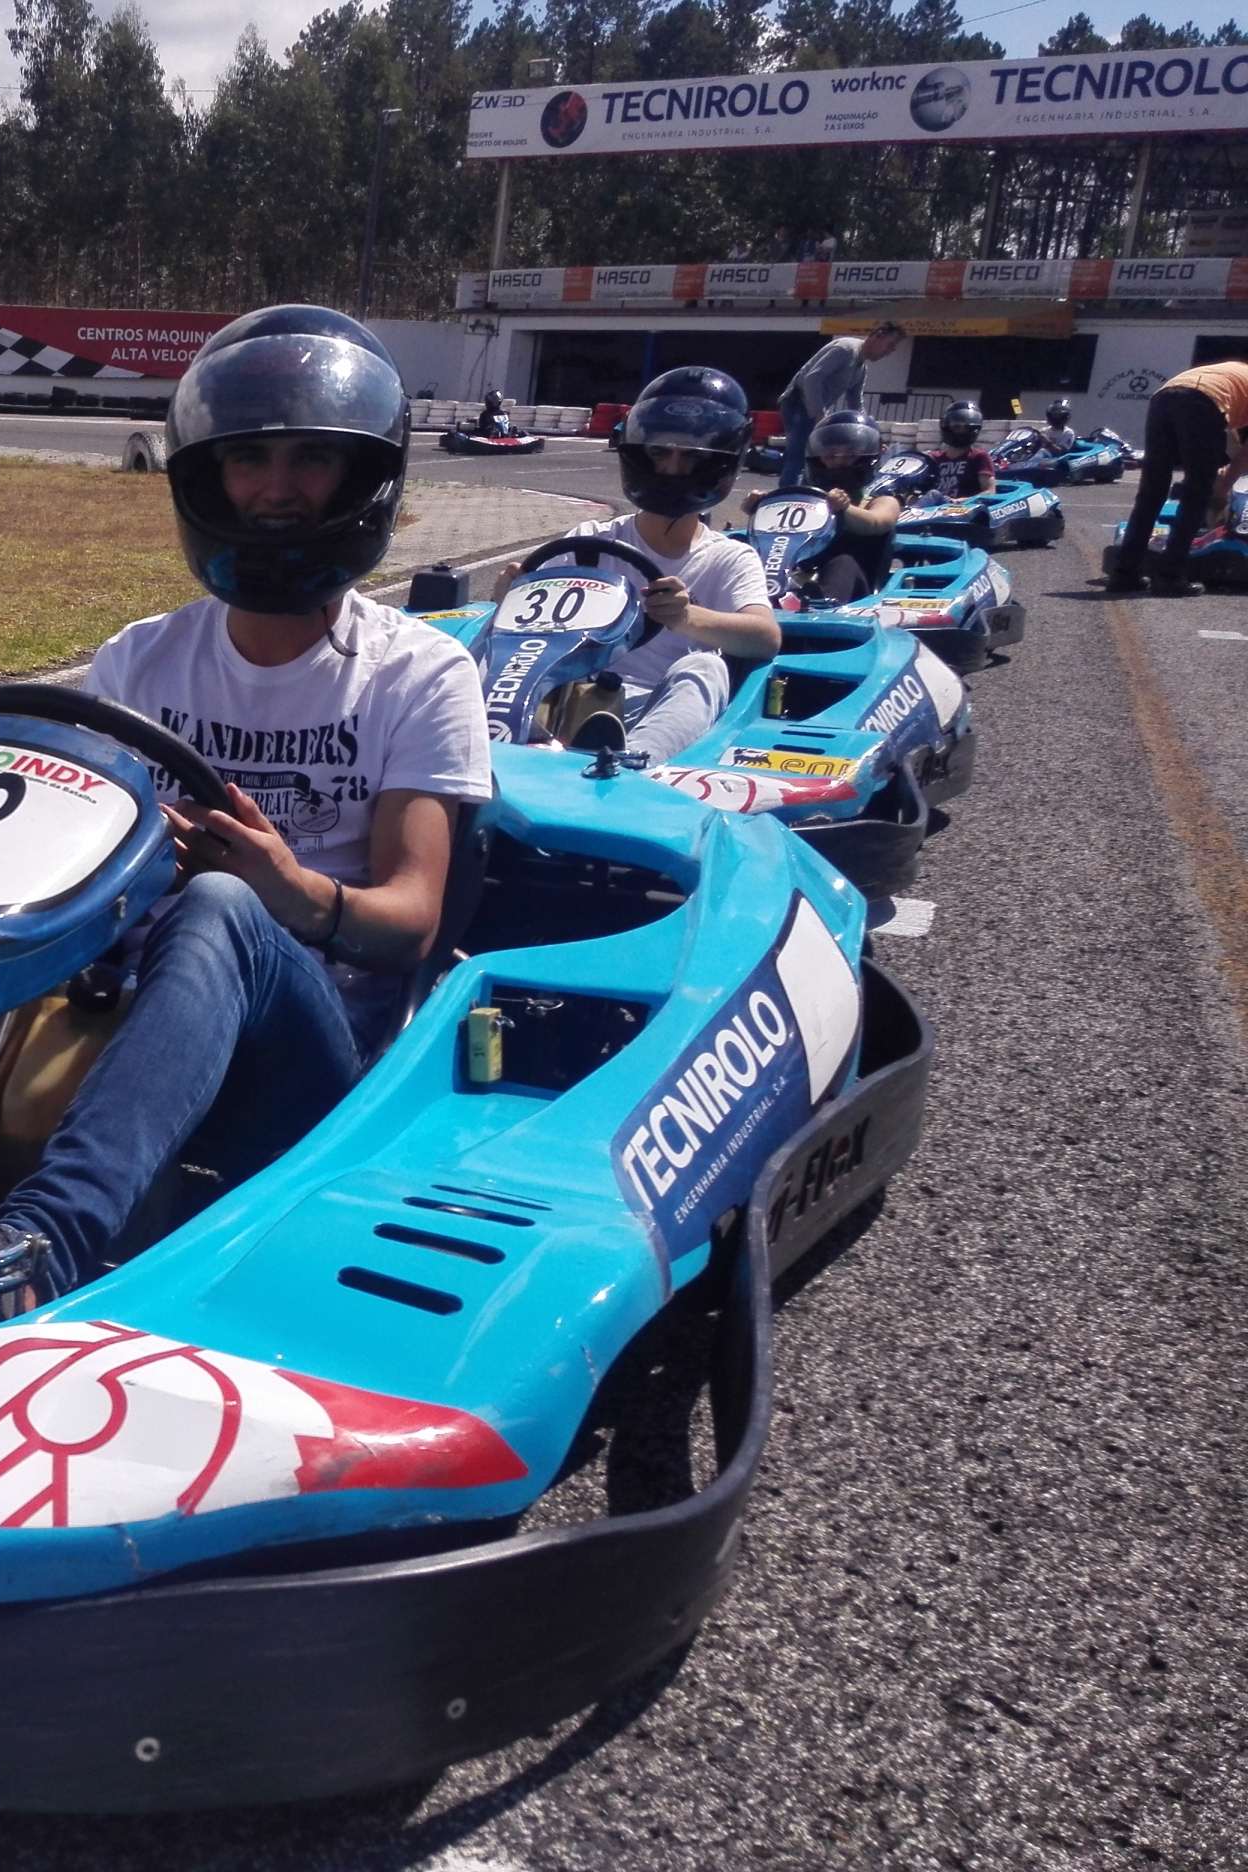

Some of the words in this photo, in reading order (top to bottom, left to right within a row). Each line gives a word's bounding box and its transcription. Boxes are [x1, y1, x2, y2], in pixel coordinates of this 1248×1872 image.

[831, 71, 907, 93] worknc
[989, 55, 1248, 104] TECNIROLO
[602, 80, 810, 124] TECNIROLO
[1016, 111, 1094, 124] ENGENHARIA
[622, 130, 683, 141] ENGENHARIA
[491, 273, 542, 288] HASCO
[596, 270, 651, 285] HASCO
[708, 268, 770, 283] HASCO
[833, 267, 900, 282] HASCO
[969, 265, 1040, 281] HASCO
[1117, 264, 1196, 280] HASCO
[77, 327, 144, 342] CENTROS
[111, 347, 148, 361] ALTA
[892, 458, 906, 471] 9
[776, 506, 807, 528] 10
[514, 586, 586, 624] 30
[486, 639, 548, 714] TECNIROLO
[860, 674, 924, 735] CNIROLO
[160, 706, 359, 768] WANDERERS
[330, 775, 370, 803] 78
[249, 790, 292, 816] REAT
[621, 990, 787, 1211] TECNIROLO
[673, 1153, 729, 1225] ENGENHARIA
